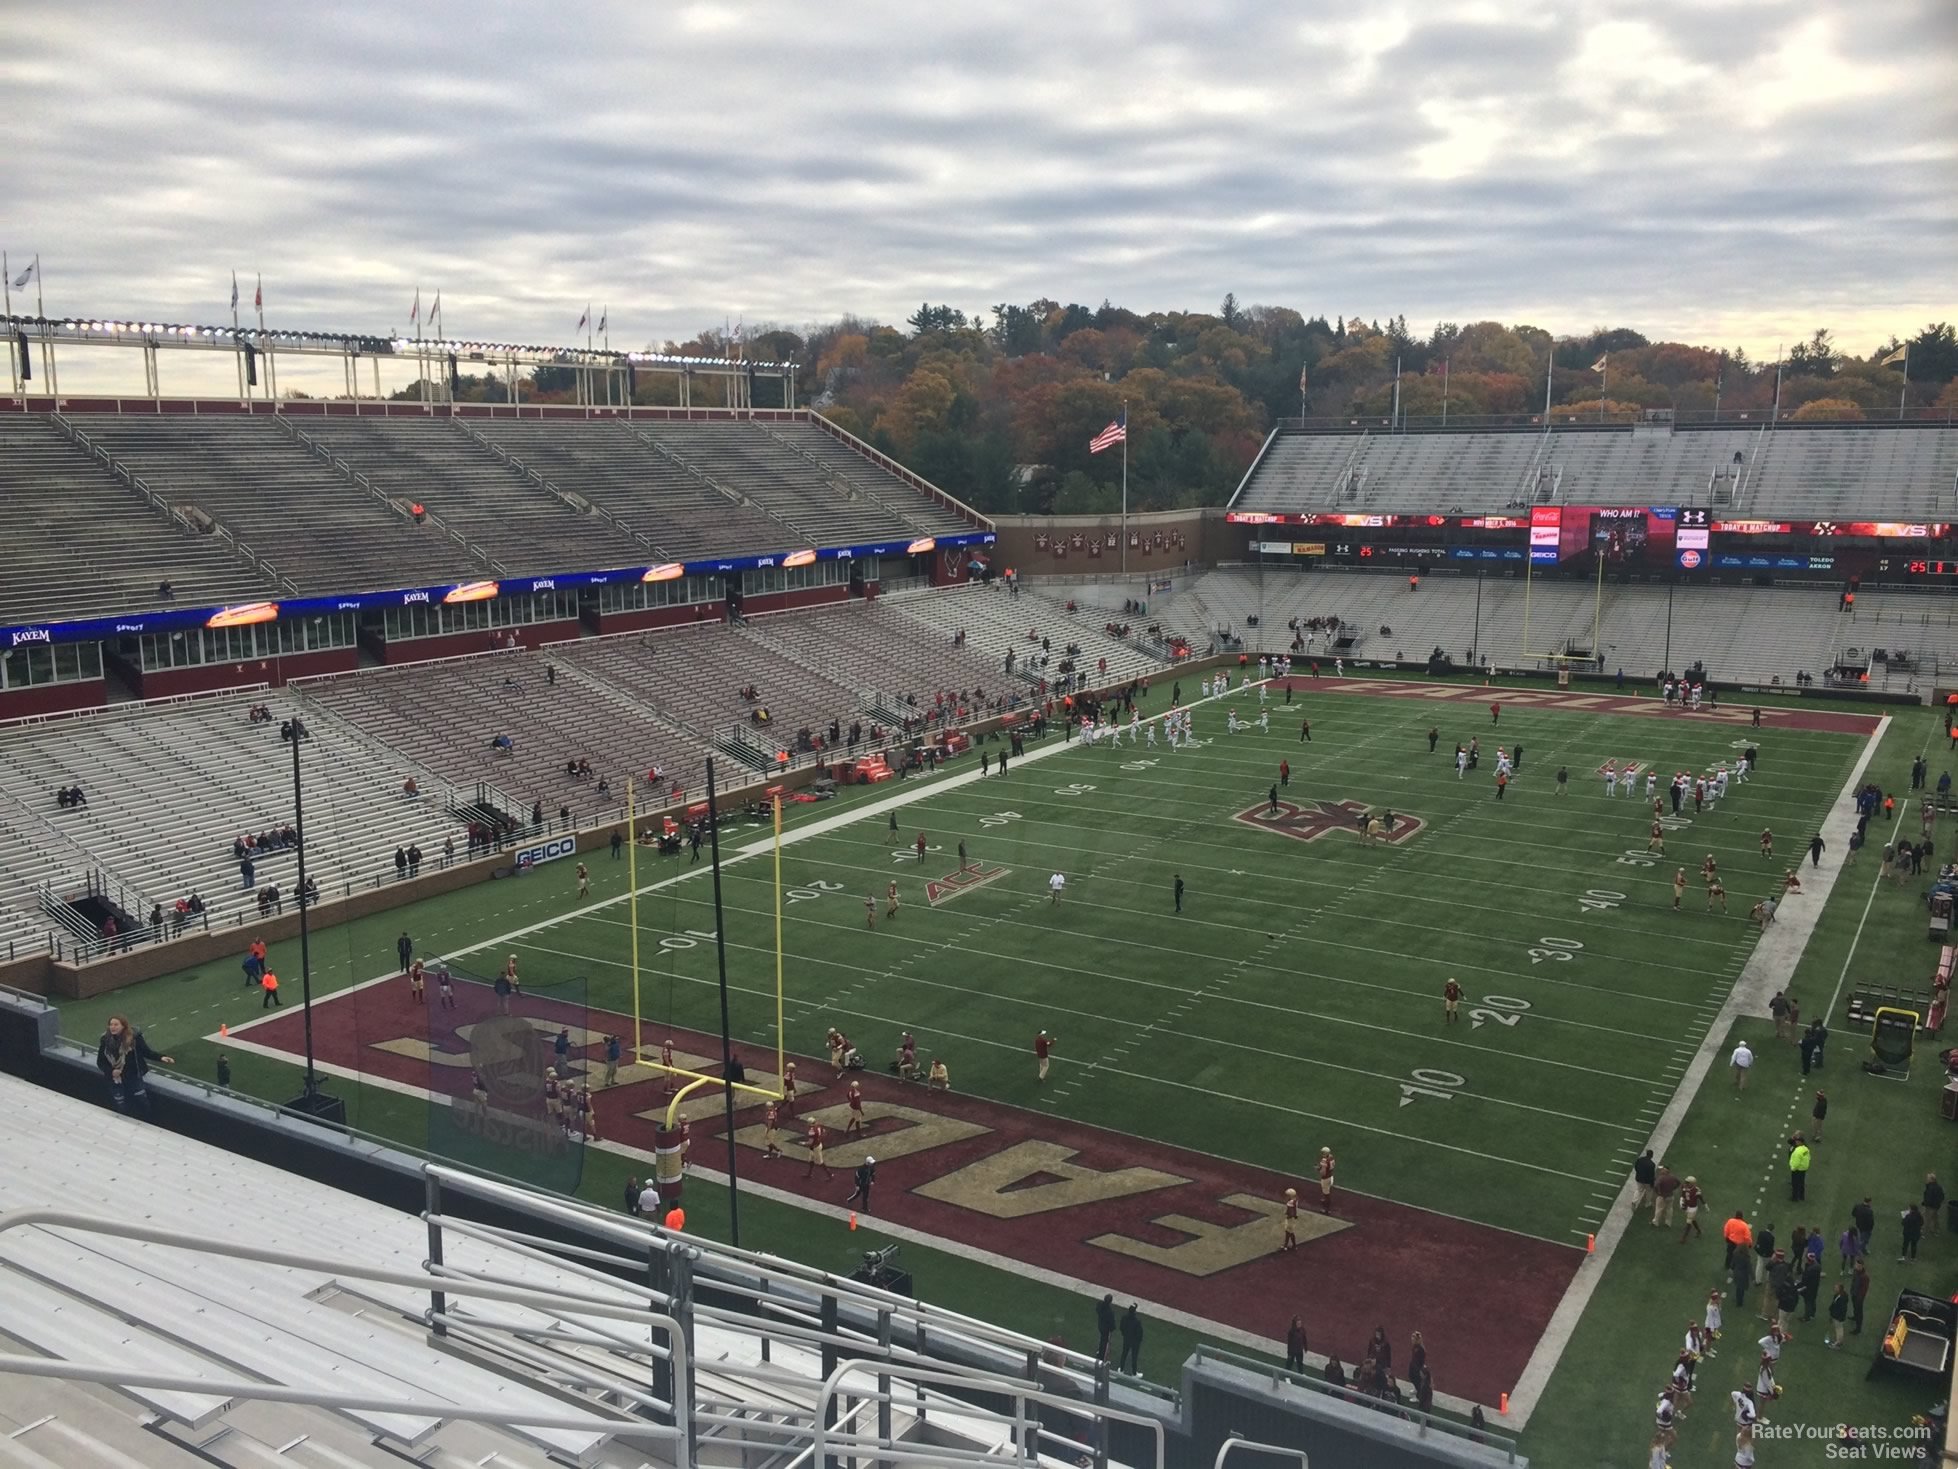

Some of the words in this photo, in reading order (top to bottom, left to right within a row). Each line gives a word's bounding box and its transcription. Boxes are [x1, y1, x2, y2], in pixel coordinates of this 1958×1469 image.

[1359, 515, 1384, 527] VS
[1600, 509, 1618, 518] WHO
[1619, 510, 1633, 518] AM
[1897, 525, 1928, 537] VS
[1360, 546, 1373, 557] 25
[1530, 551, 1557, 559] GEICO
[1910, 561, 1926, 573] 25
[532, 579, 555, 592] KAYEM
[403, 592, 430, 605] KAYEM
[12, 629, 51, 646] KAYEM
[1322, 681, 1793, 722] EAGLES
[1054, 783, 1097, 796] 50
[979, 810, 1023, 826] 40
[517, 837, 575, 864] GEICO
[1615, 849, 1664, 867] 50
[784, 879, 845, 901] 20
[924, 860, 1011, 904] ACC
[1577, 889, 1628, 910] 40
[657, 929, 719, 950] 10
[1527, 937, 1584, 962] 30
[1468, 995, 1533, 1027] 20
[1399, 1068, 1467, 1100] 10
[368, 1016, 1358, 1278] EAGLES
